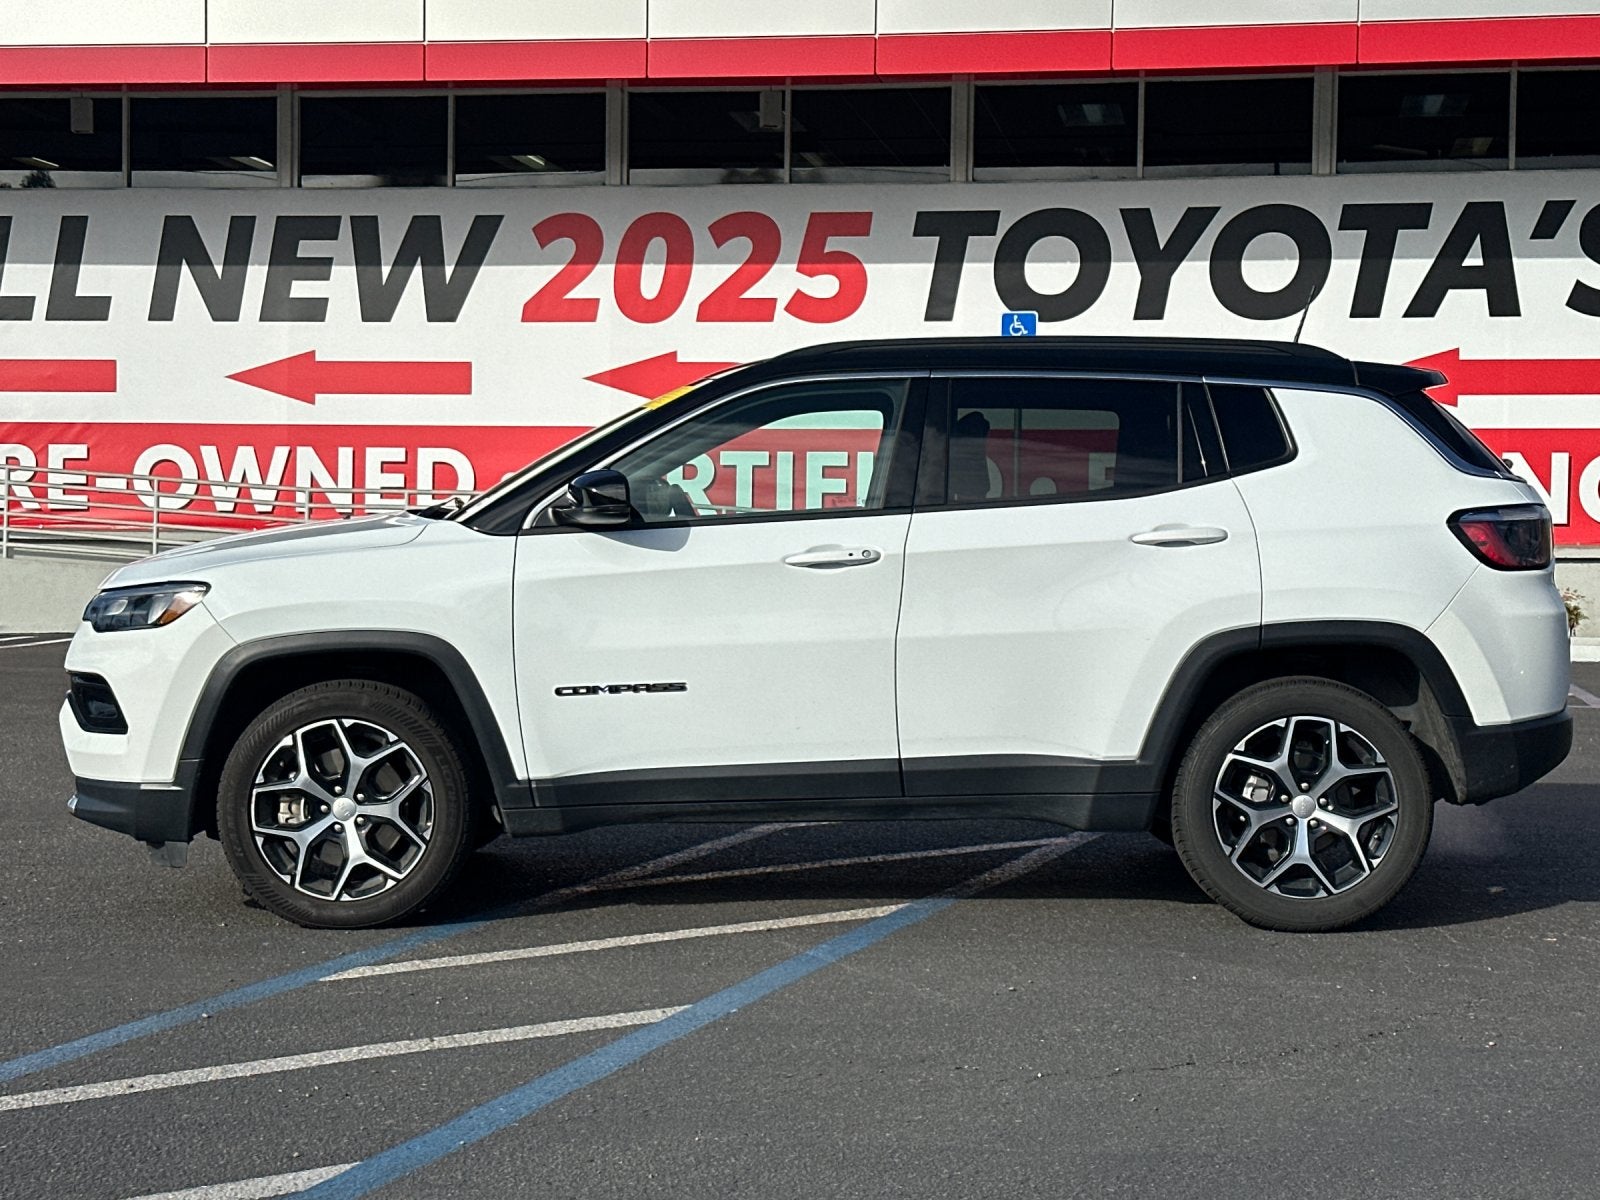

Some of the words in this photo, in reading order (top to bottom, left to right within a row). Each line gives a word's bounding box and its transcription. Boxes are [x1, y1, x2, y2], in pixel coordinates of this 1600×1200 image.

[148, 215, 504, 322] NEW
[521, 210, 873, 324] 2025
[554, 682, 688, 696] COMPASS
